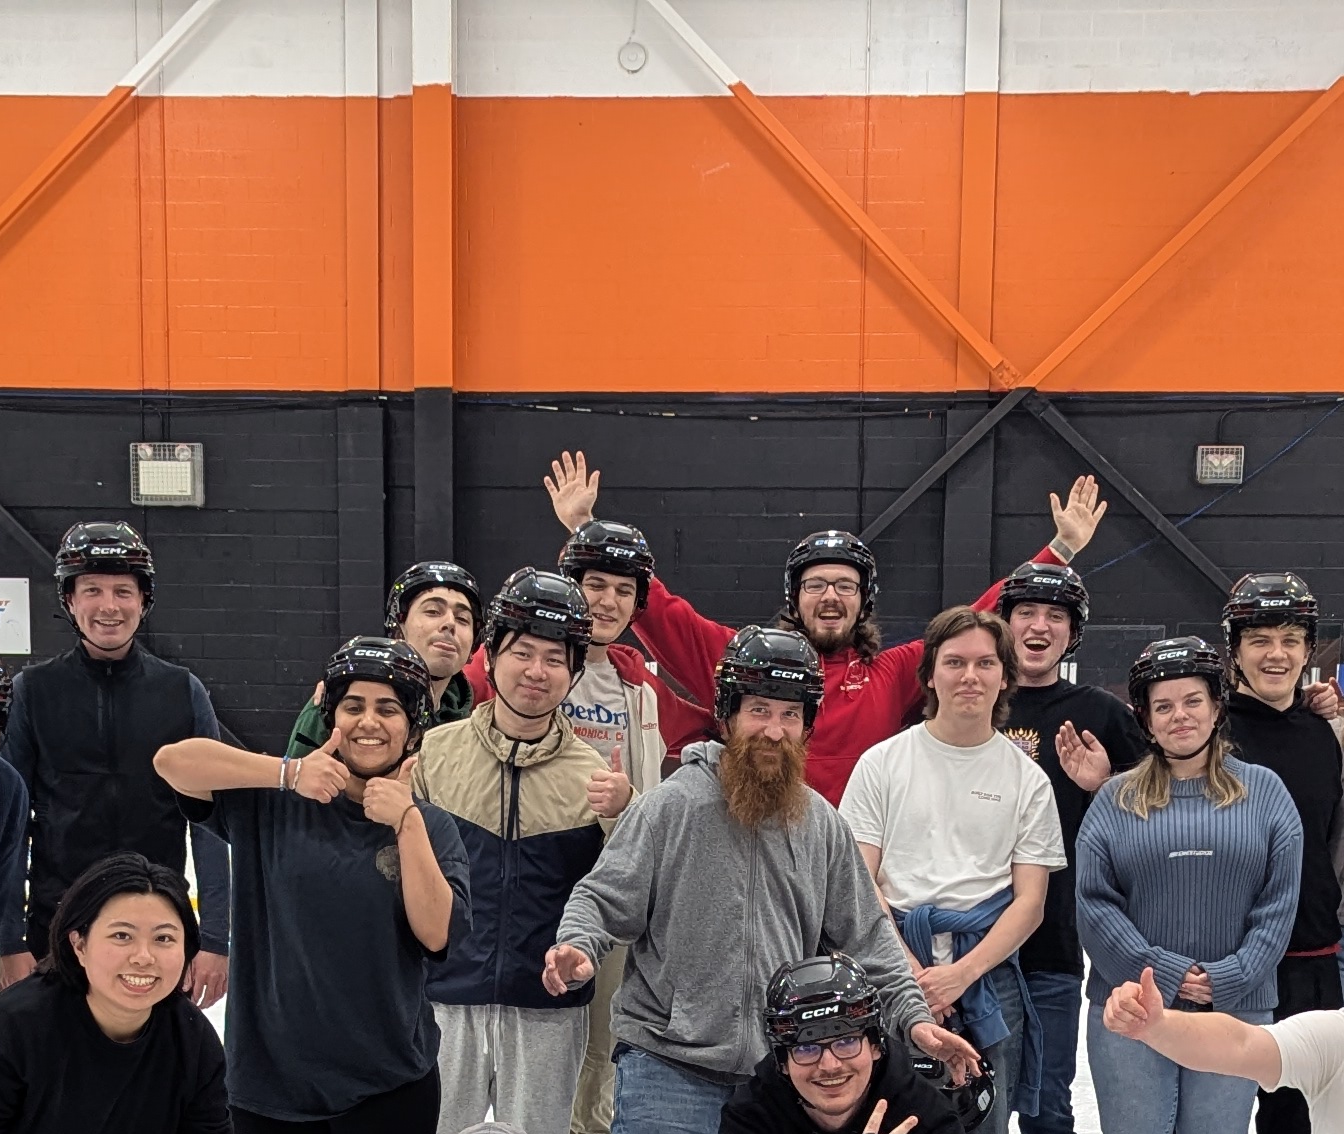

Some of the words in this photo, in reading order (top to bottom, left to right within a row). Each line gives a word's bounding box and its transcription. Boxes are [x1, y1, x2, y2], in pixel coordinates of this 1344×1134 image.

[605, 545, 636, 558] CCM
[1032, 576, 1063, 586] CCM
[1260, 599, 1291, 607] CCM
[536, 609, 568, 622] CCM
[354, 649, 391, 659] CCM
[1157, 650, 1188, 661] CCM
[771, 669, 805, 680] CCM
[560, 703, 628, 730] perDry
[801, 1004, 840, 1020] CCM
